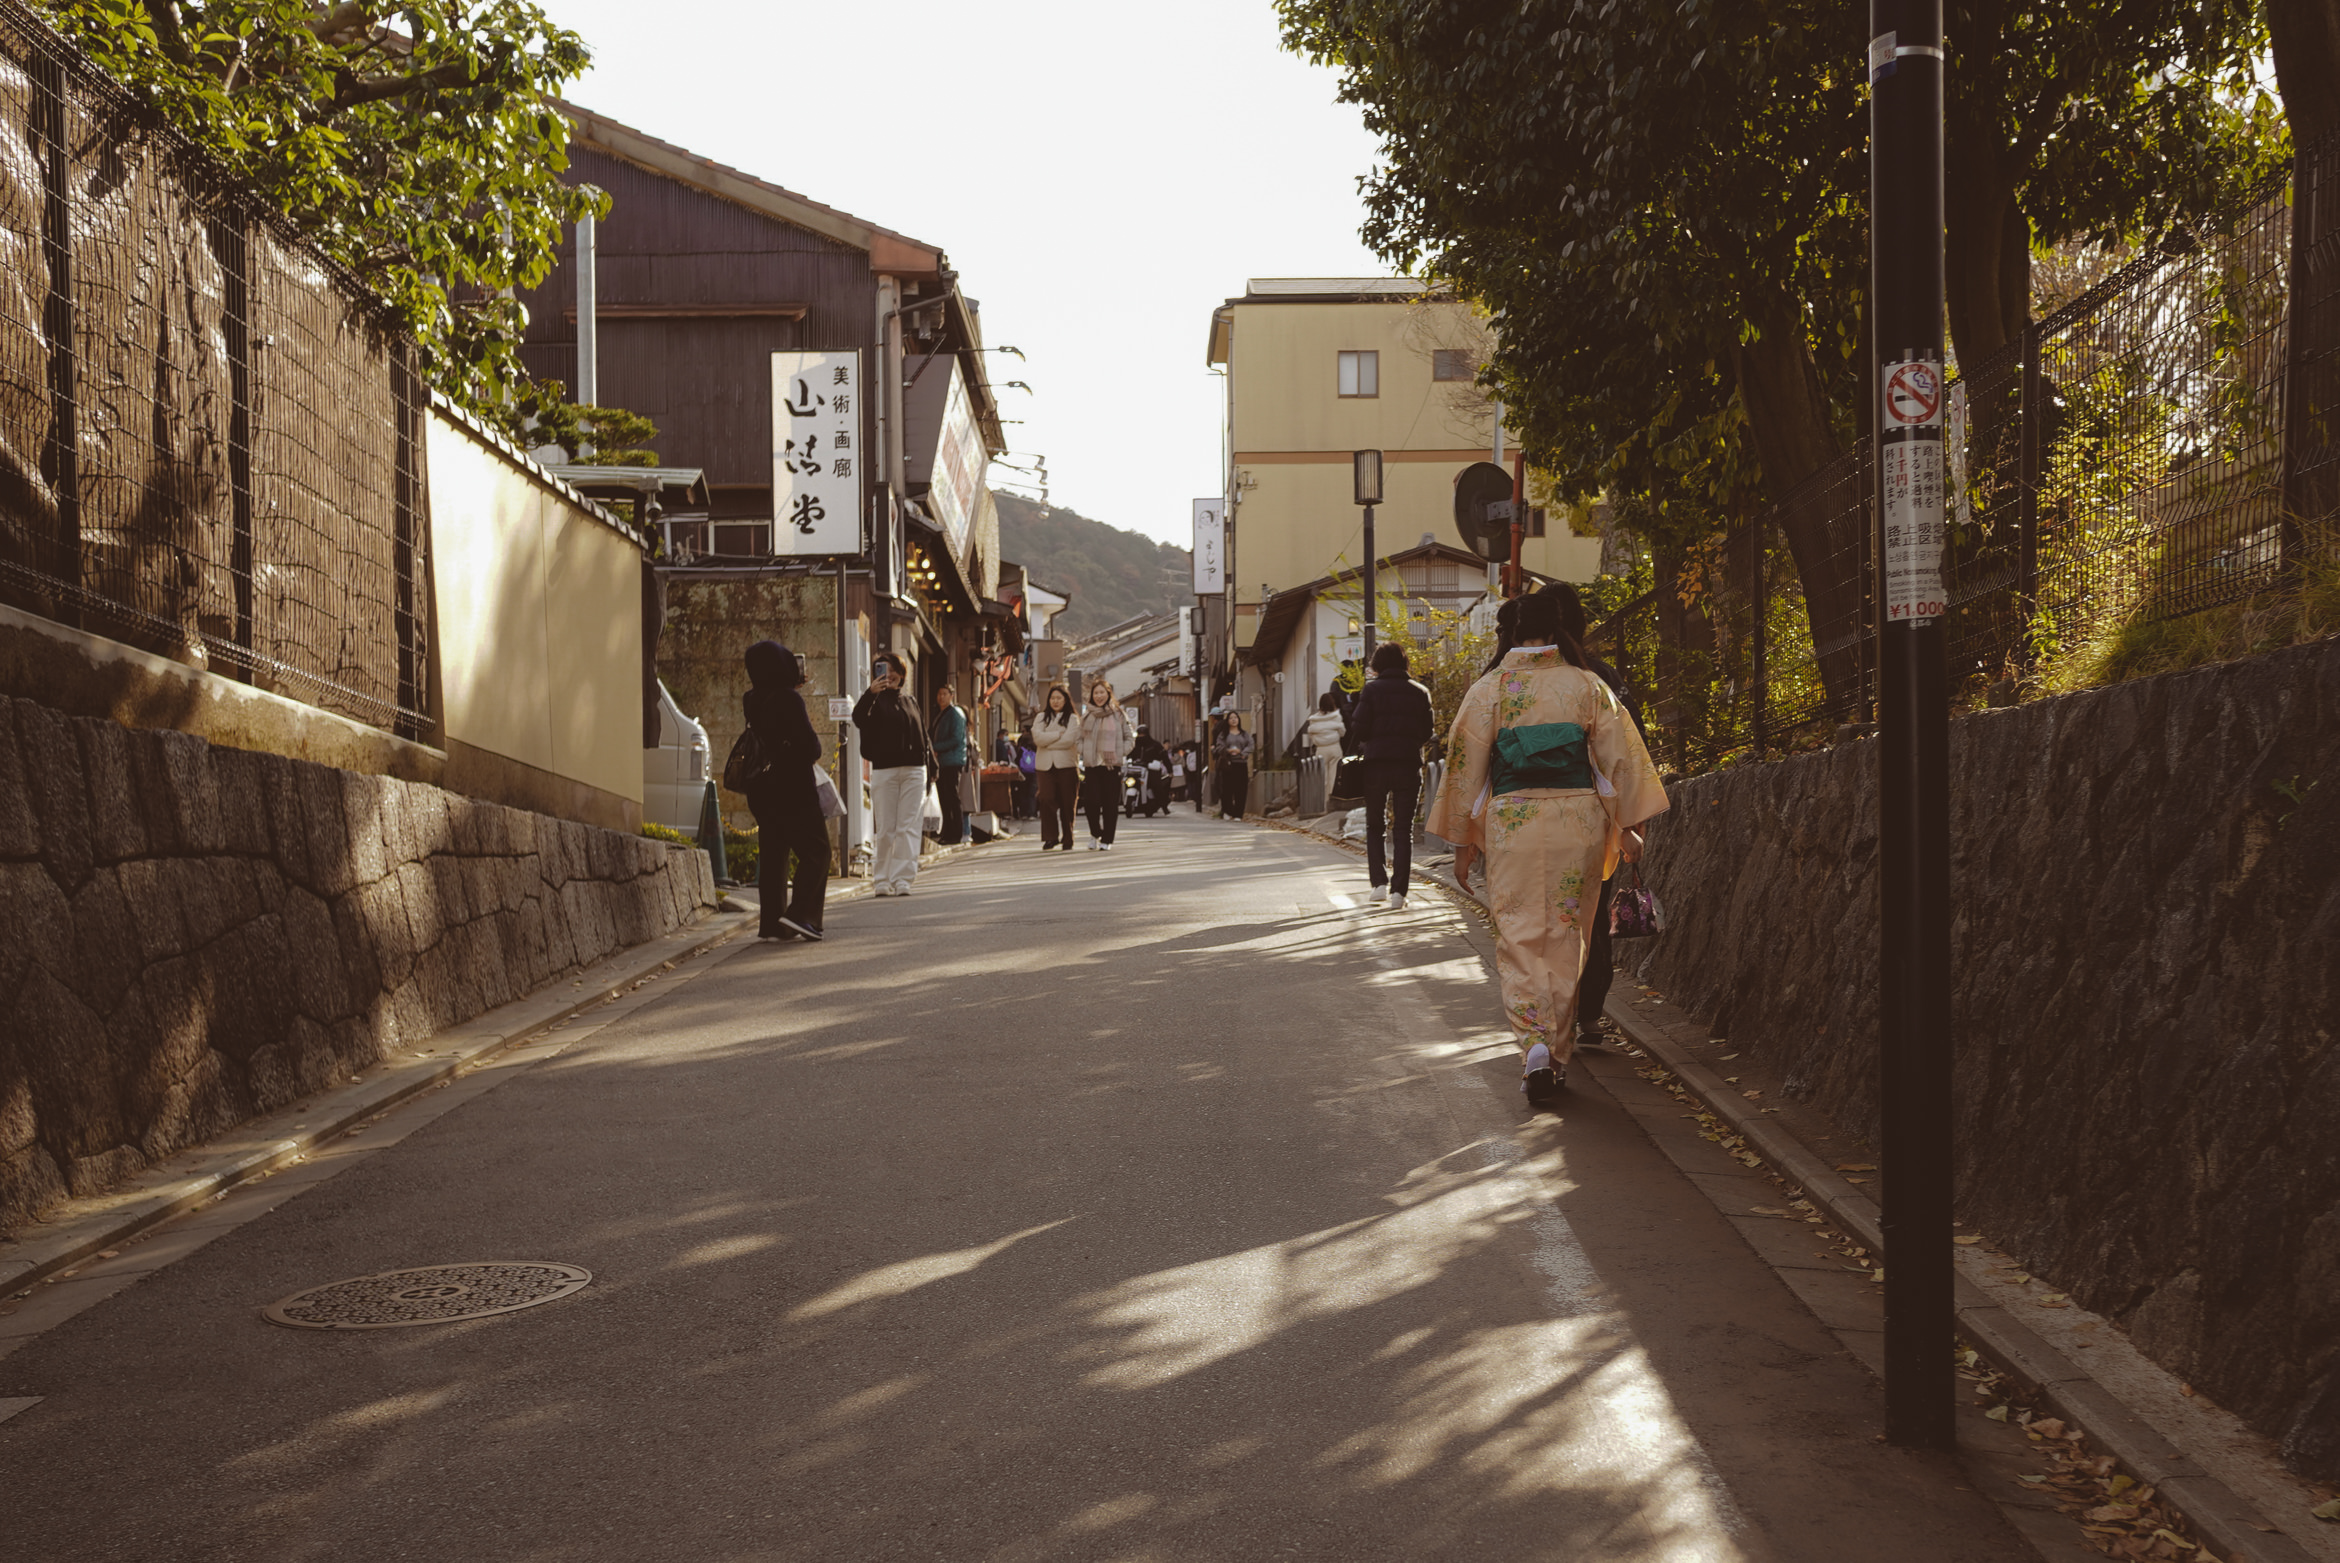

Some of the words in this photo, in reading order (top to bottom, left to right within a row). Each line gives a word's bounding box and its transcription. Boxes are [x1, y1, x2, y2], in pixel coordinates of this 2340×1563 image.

[832, 365, 852, 479] 美術・画廊
[1889, 601, 1945, 618] ¥1,000
